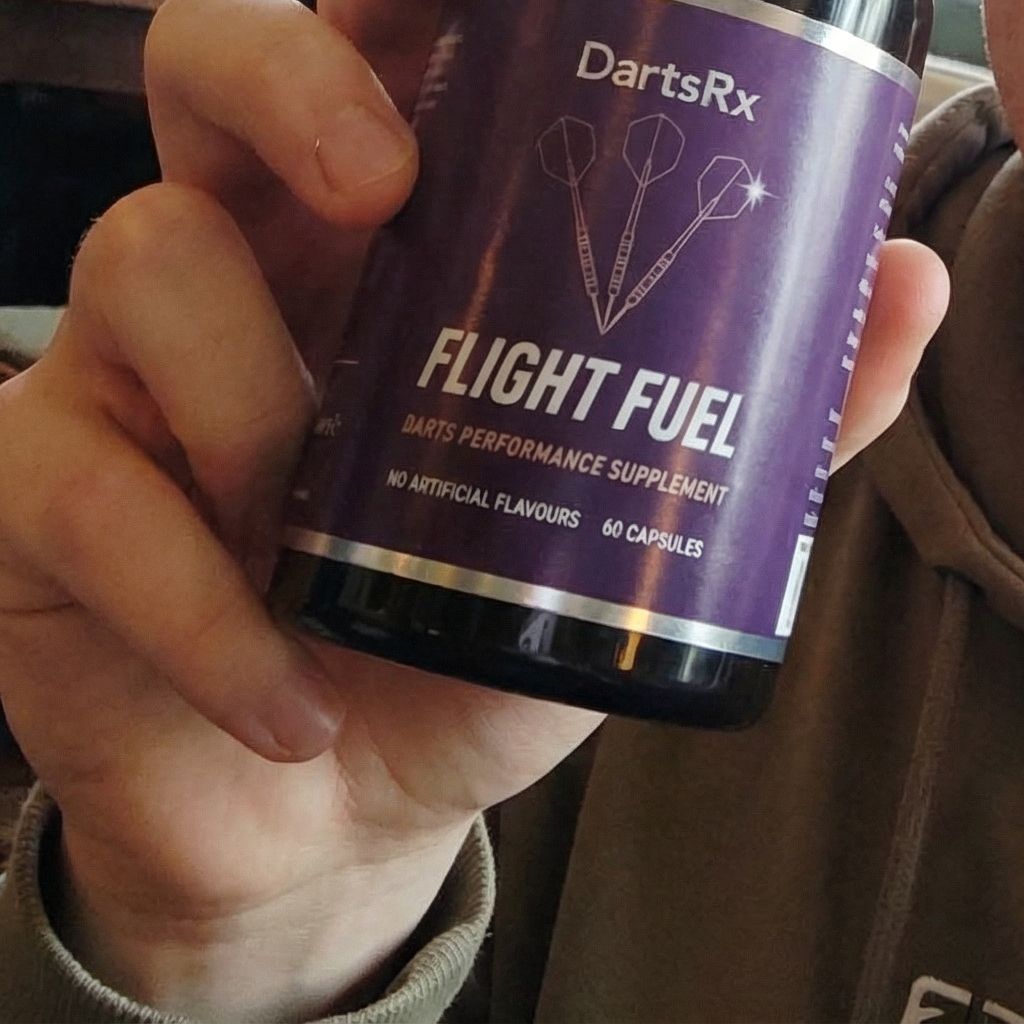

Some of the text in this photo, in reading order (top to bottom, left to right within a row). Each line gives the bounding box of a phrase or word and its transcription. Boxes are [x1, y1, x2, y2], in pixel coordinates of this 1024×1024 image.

[576, 40, 761, 122] DartsRx
[416, 326, 745, 459] FLIGHT FUEL
[401, 413, 730, 506] DARTS PERFORMANCE SUPPLEMENT
[386, 468, 705, 559] NO ARTIFICIAL FLAVOURS 60 CAPSULES
